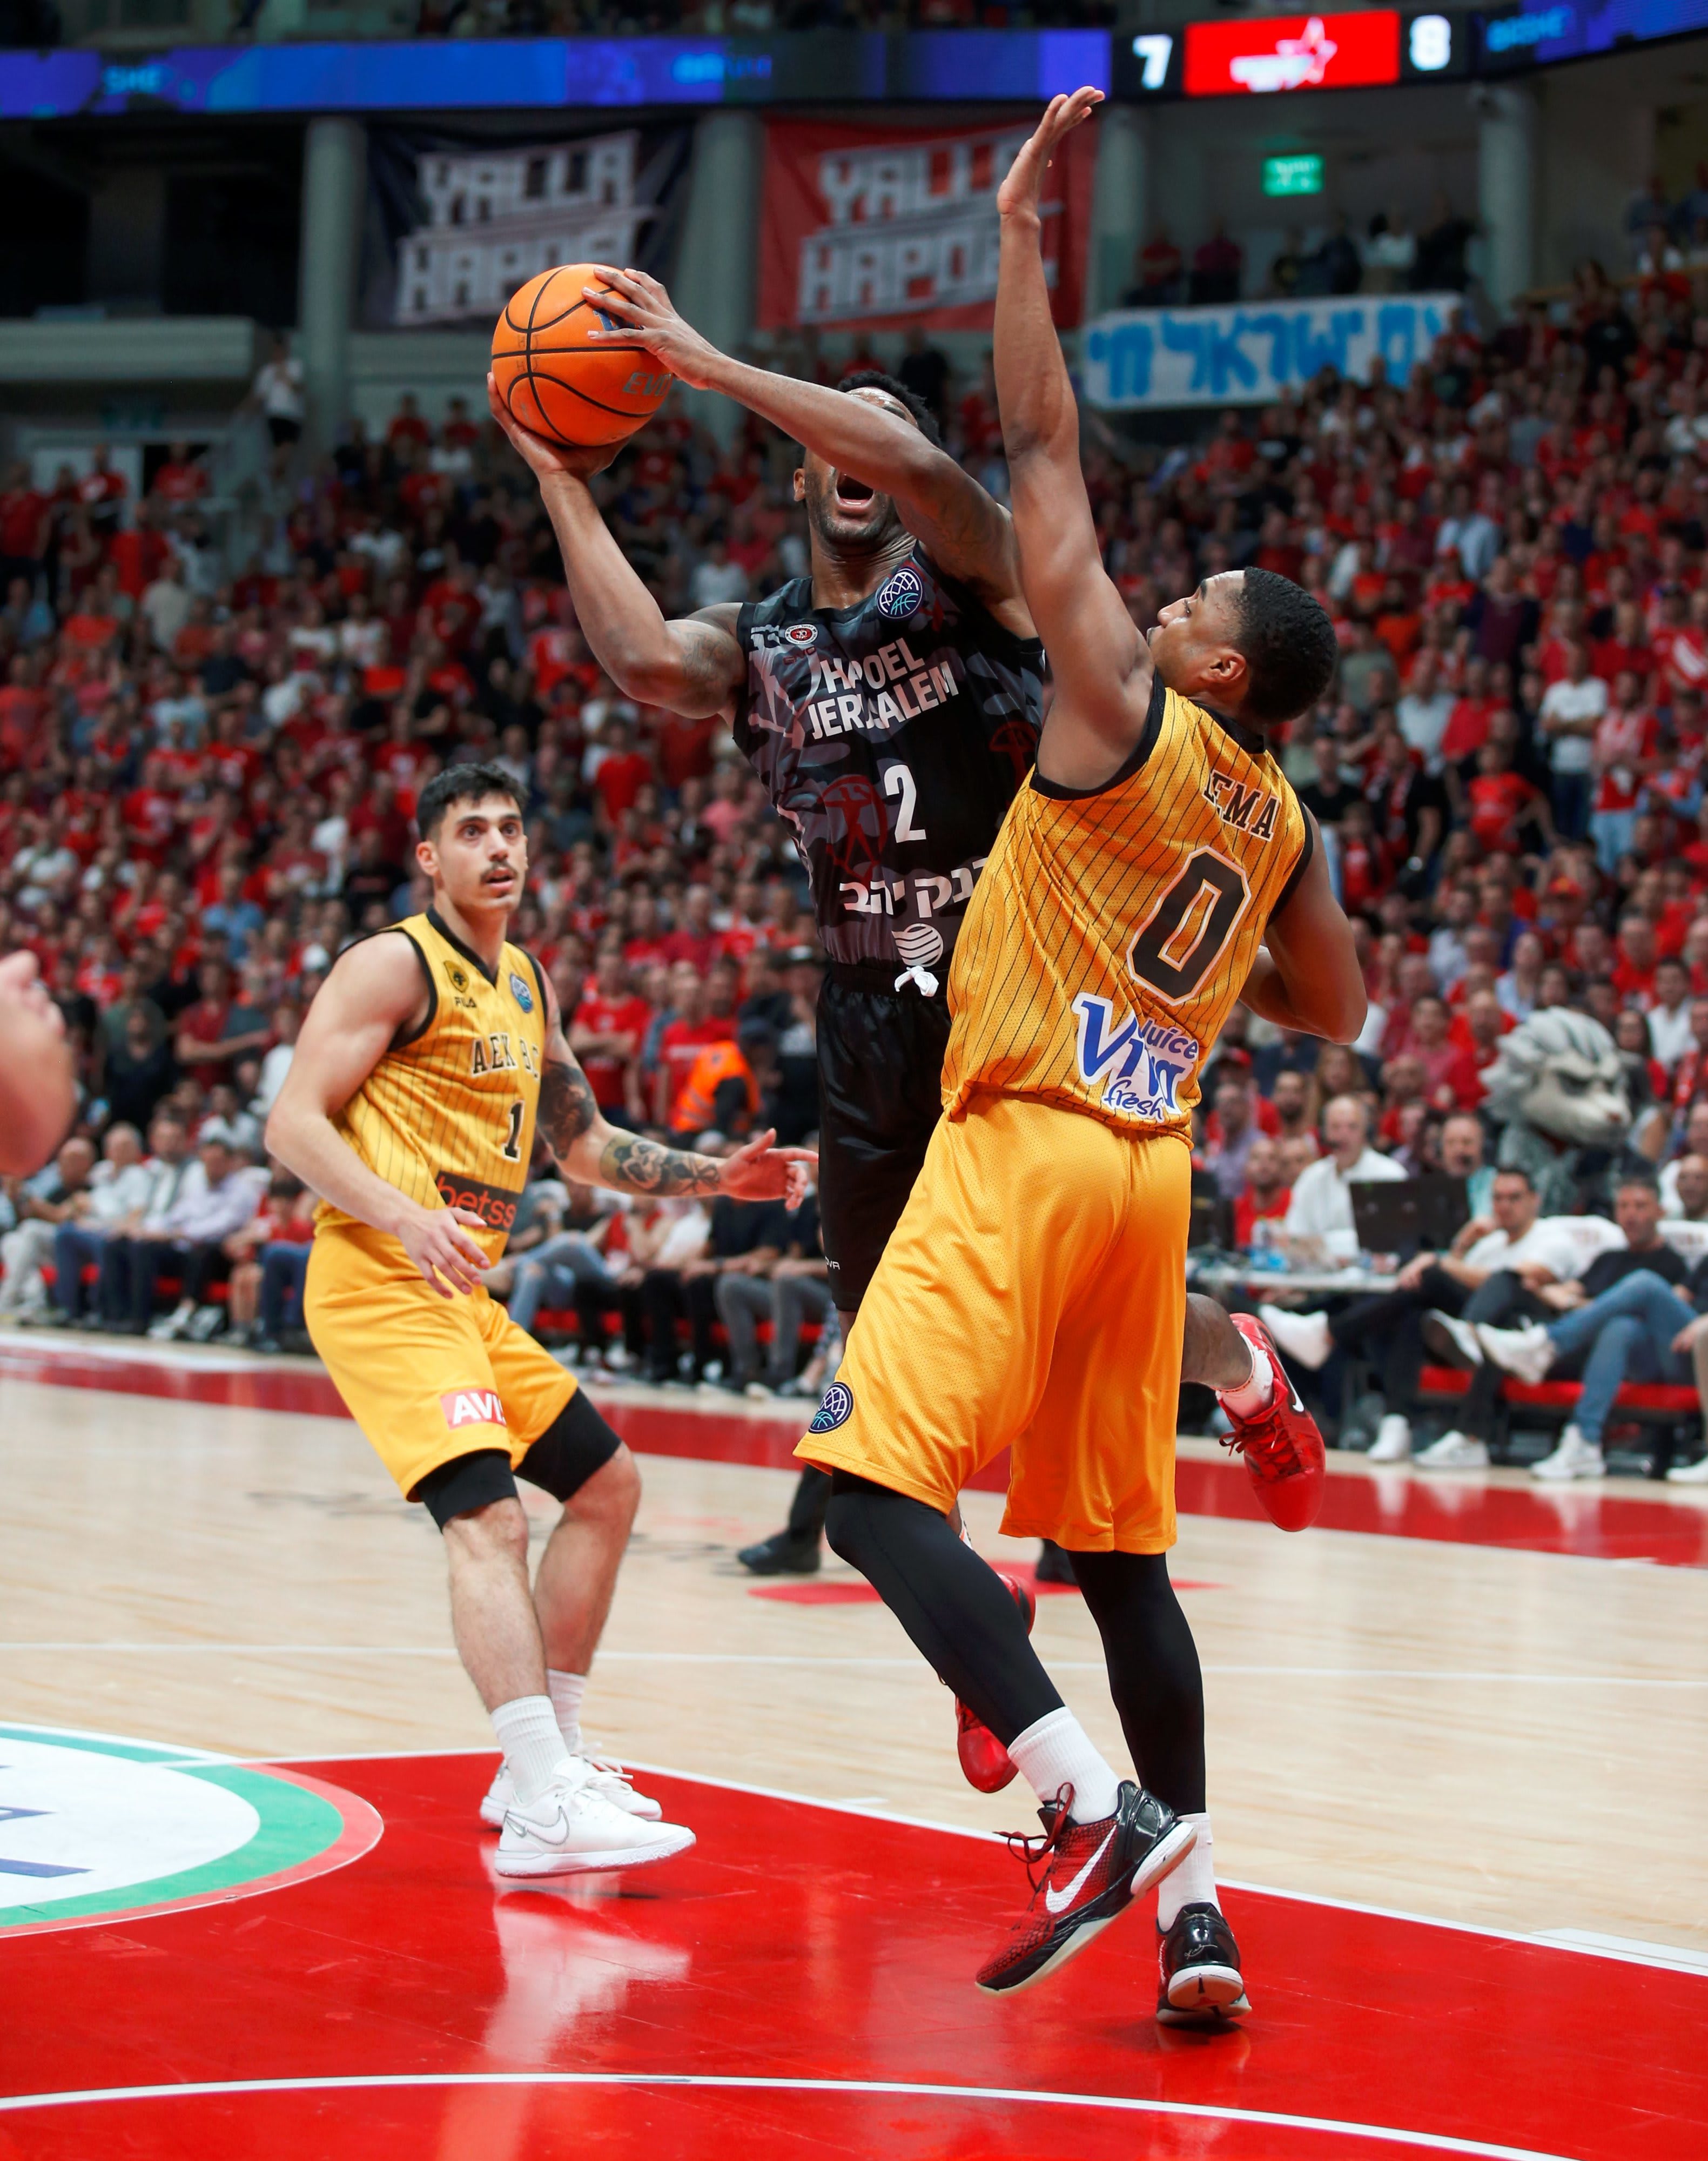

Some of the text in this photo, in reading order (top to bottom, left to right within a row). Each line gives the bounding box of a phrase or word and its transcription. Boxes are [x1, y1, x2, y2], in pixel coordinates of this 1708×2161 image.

[1133, 34, 1173, 90] 7
[1410, 14, 1451, 72] 8
[417, 130, 640, 226] YALLA
[884, 764, 927, 843] 2
[839, 881, 905, 915] יהב
[1126, 845, 1251, 1005] 0
[471, 1032, 519, 1078] AEK
[503, 1099, 525, 1162] 1
[452, 1392, 507, 1425] AVI
